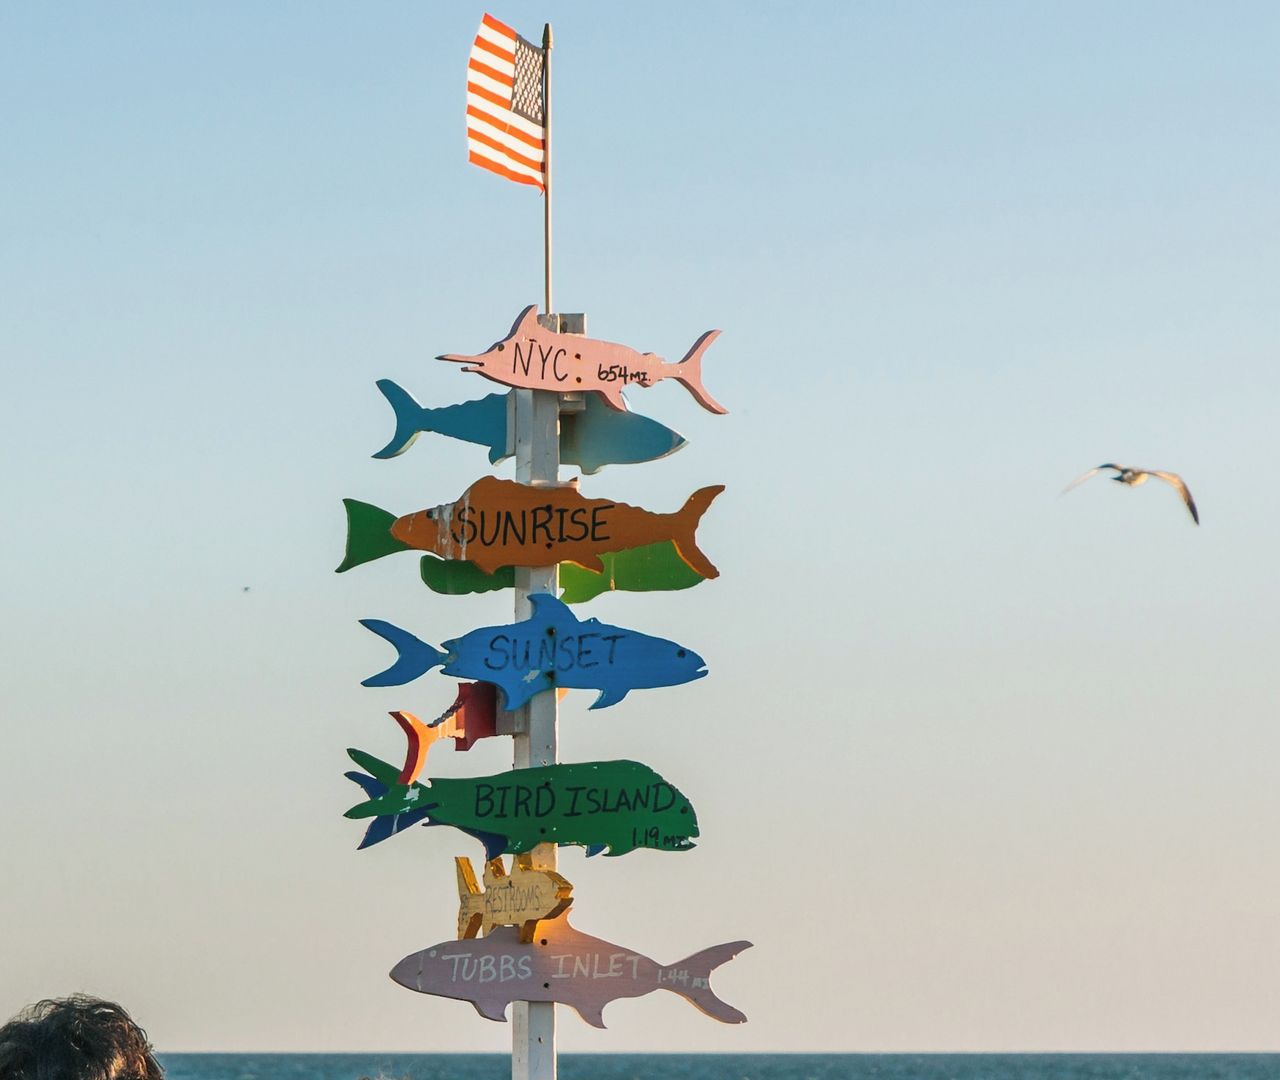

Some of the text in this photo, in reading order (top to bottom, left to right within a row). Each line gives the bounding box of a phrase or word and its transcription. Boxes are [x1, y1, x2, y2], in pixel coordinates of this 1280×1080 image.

[513, 341, 569, 382] NYC
[451, 504, 615, 547] SUNRISE
[484, 633, 627, 671] SUNSET
[474, 782, 677, 818] BIRD ISLAND
[632, 826, 659, 848] 1.19
[485, 884, 541, 913] RESTROOMS
[441, 953, 641, 983] TUBBS INLET
[657, 968, 690, 987] 1.44
